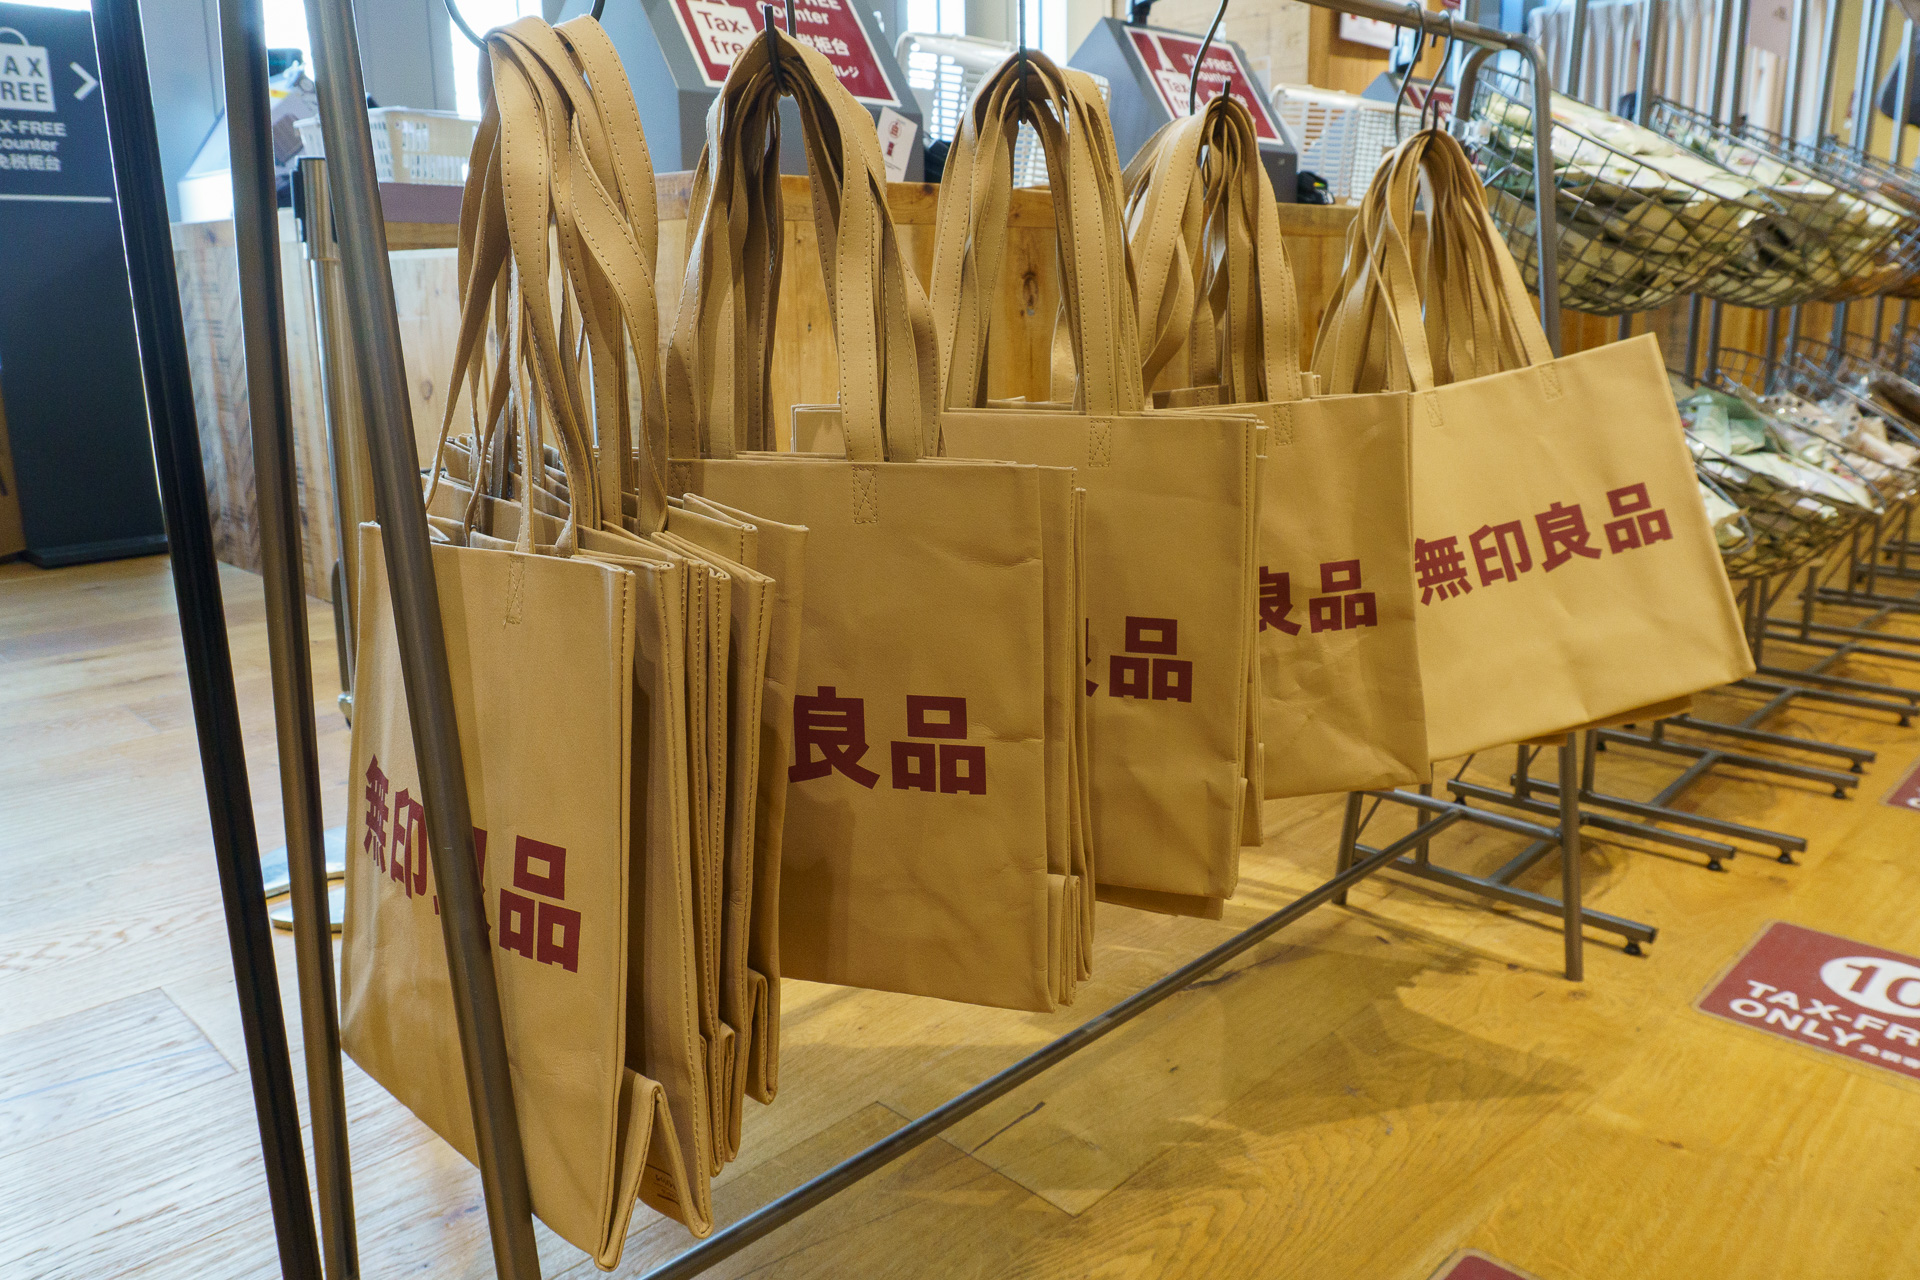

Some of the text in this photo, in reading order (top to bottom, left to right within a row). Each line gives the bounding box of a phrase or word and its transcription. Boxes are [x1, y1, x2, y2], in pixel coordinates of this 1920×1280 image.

[697, 10, 749, 35] Tax-
[756, 0, 829, 25] Conter
[710, 35, 745, 55] fre
[0, 137, 59, 152] ounter
[1414, 482, 1673, 606] 無印良品
[1259, 559, 1377, 636] 良品
[788, 686, 986, 795] 良品
[364, 754, 581, 973] 無印品
[1729, 998, 1865, 1047] ONLY
